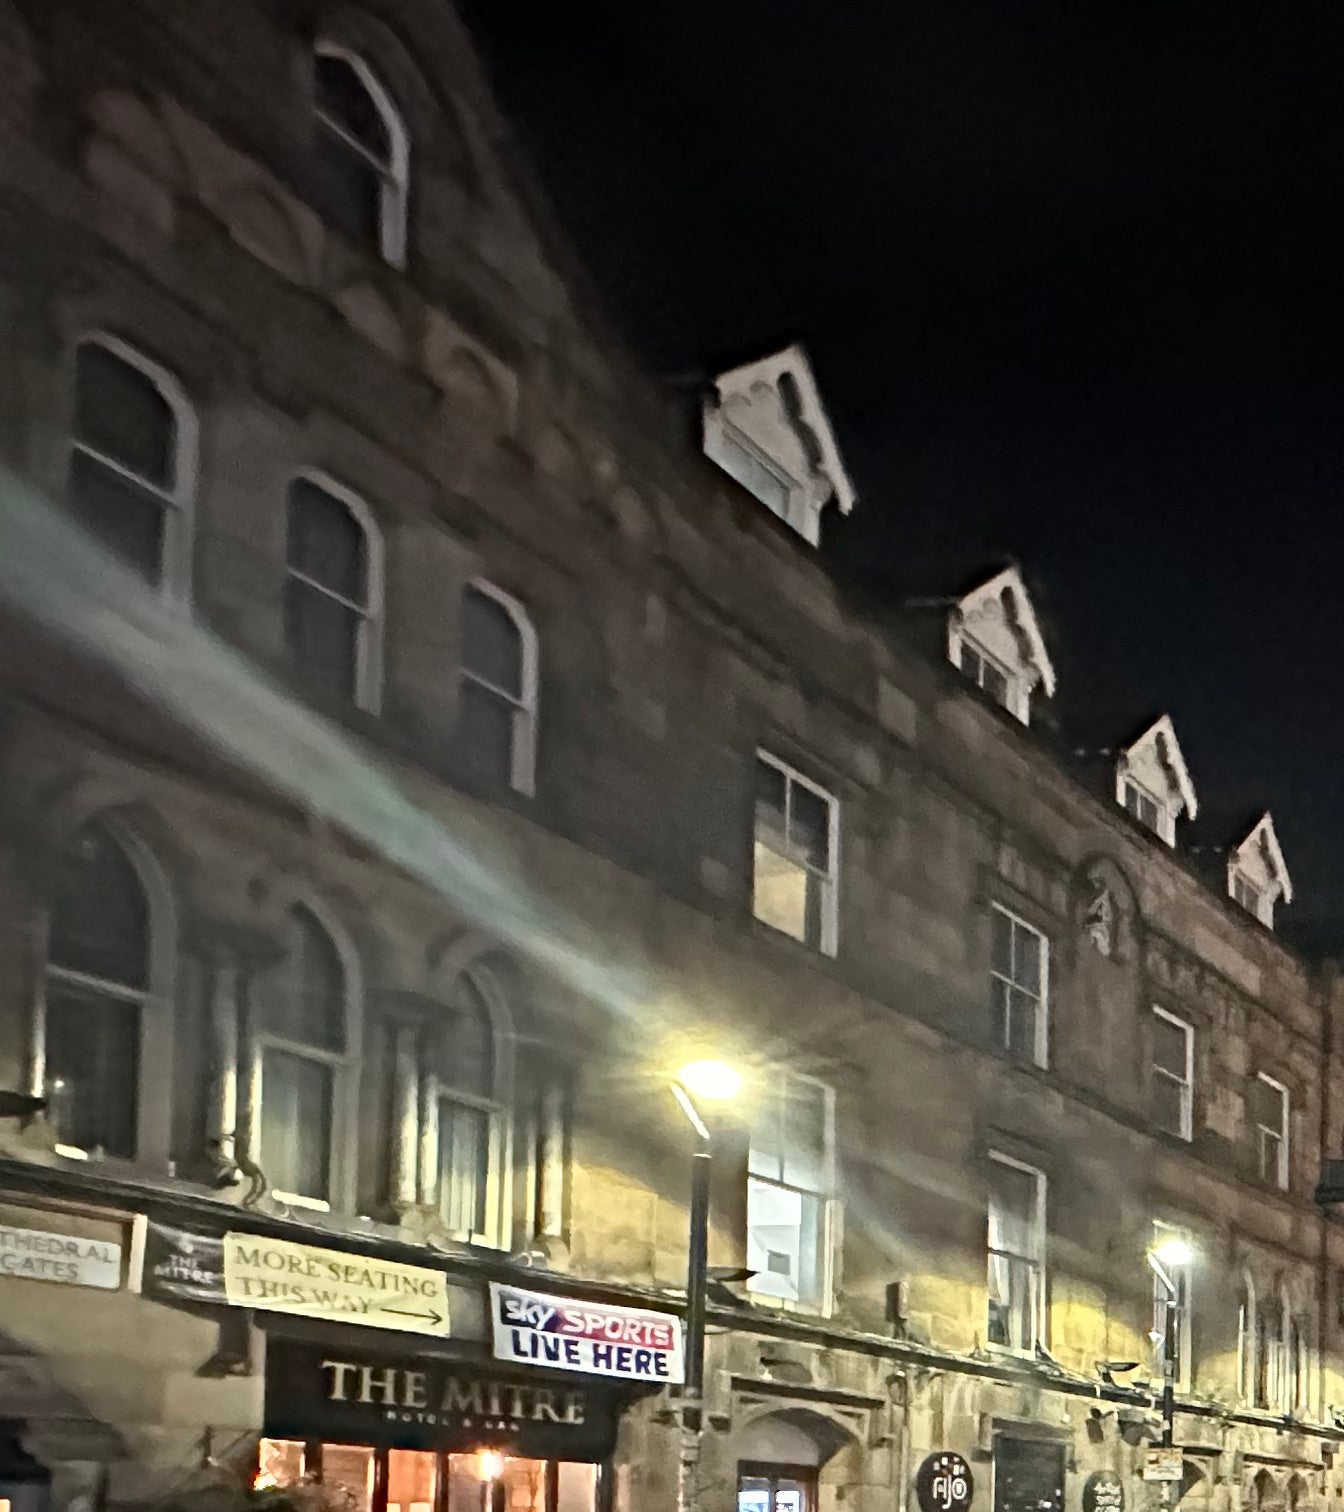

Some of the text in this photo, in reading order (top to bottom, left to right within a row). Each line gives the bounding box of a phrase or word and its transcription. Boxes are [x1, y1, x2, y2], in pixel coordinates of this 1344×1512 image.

[235, 1245, 438, 1298] MORE SEATING
[235, 1277, 372, 1314] THIS WAY
[563, 1310, 670, 1346] SPORTS
[512, 1329, 669, 1376] LIVE HERE
[320, 1360, 586, 1425] THE MITRE
